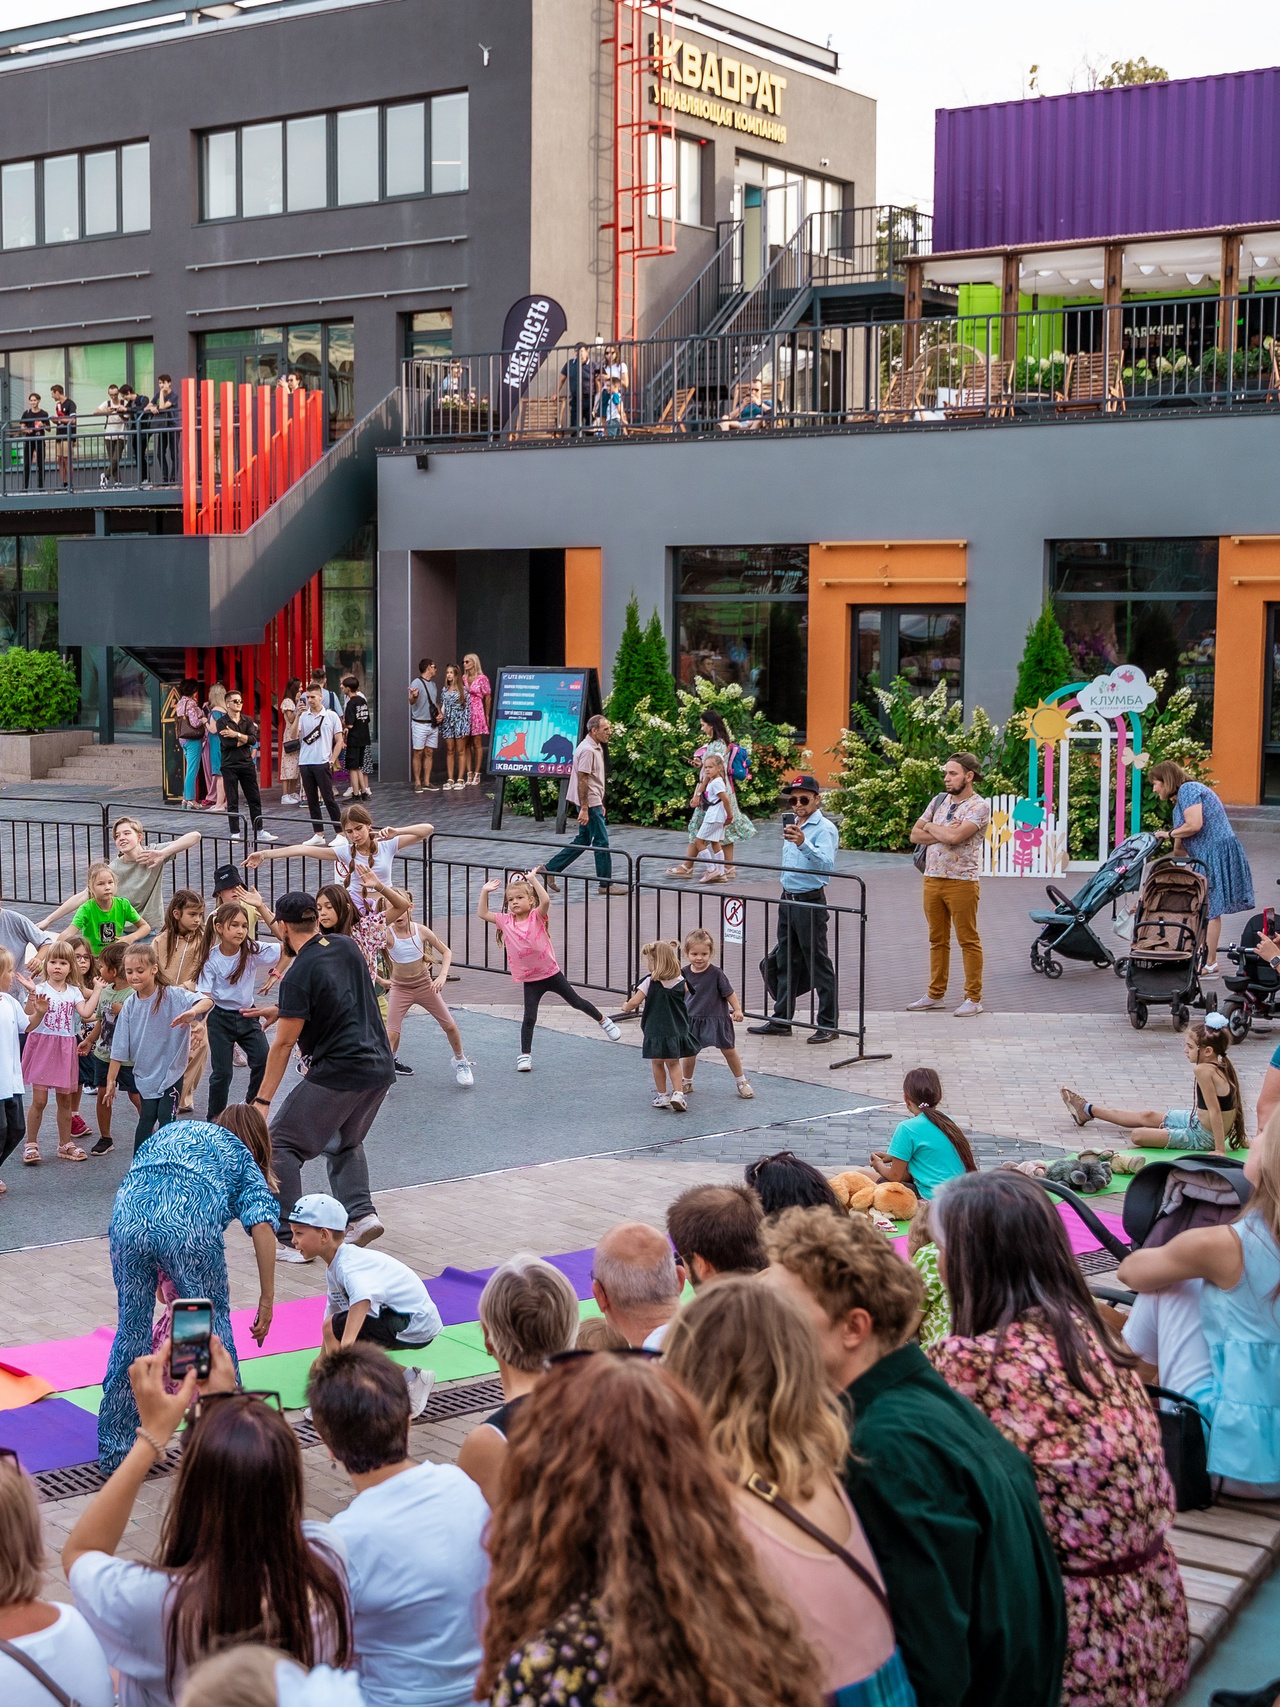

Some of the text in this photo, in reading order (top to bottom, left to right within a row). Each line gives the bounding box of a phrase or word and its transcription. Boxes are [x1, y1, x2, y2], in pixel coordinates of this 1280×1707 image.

[662, 34, 787, 116] КВАДРАТ
[734, 110, 787, 144] КОМПАНИЯ
[1090, 695, 1143, 706] КЛУМБА
